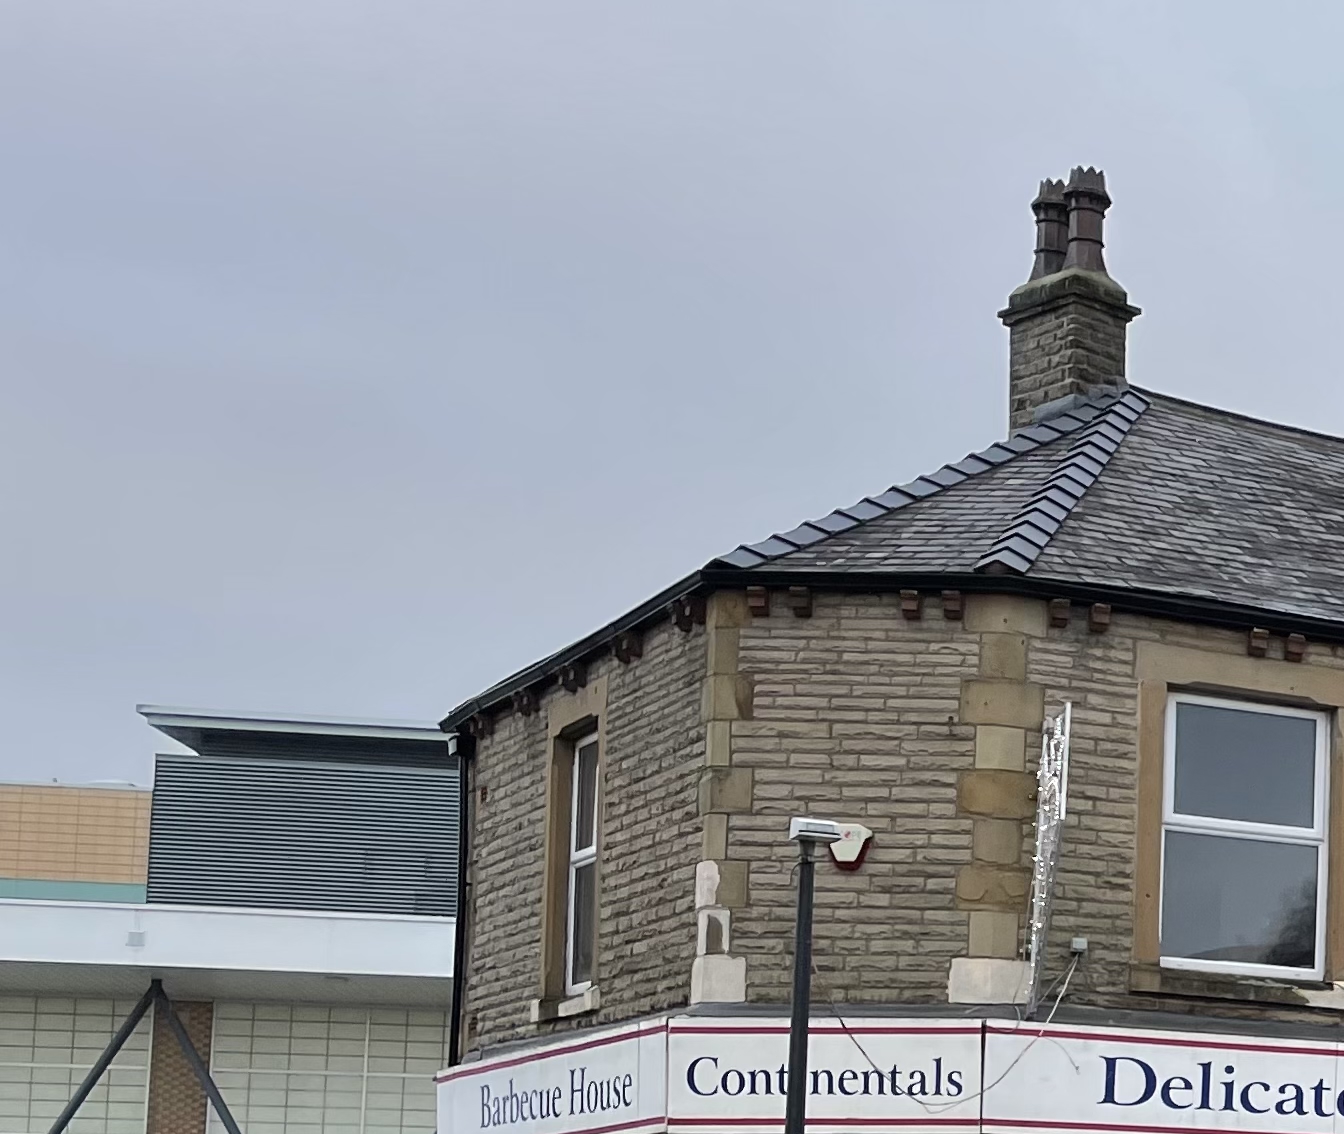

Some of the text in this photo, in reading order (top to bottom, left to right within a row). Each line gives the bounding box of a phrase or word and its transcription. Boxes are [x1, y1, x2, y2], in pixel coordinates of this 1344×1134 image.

[480, 1067, 633, 1128] Barbecue House
[686, 1056, 964, 1096] Contnentals
